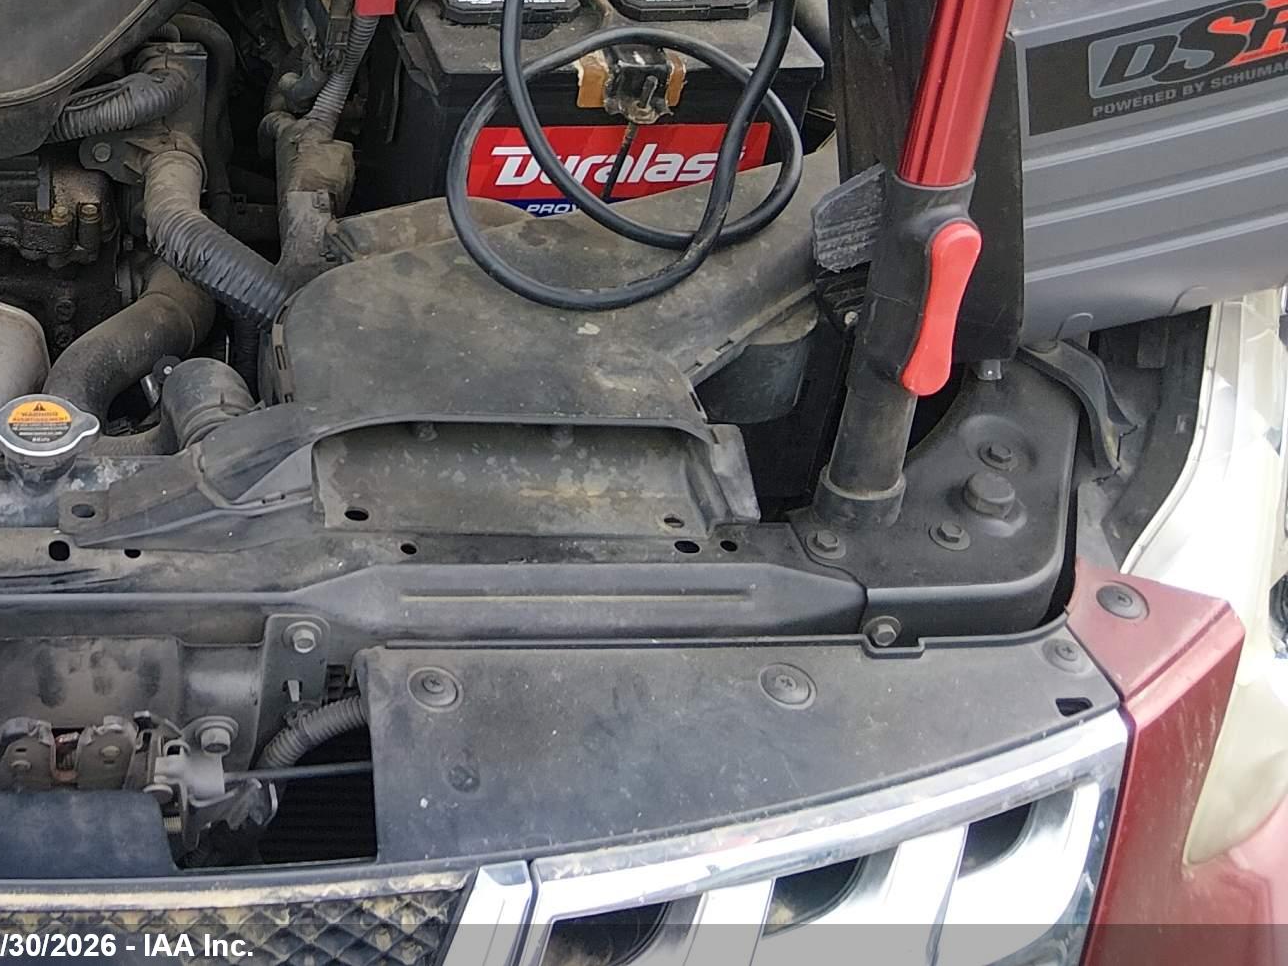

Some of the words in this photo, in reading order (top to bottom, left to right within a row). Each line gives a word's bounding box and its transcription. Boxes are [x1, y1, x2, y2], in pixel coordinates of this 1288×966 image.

[1092, 88, 1177, 117] POWERED
[1182, 82, 1207, 97] BY
[1210, 61, 1288, 89] SCHUMA
